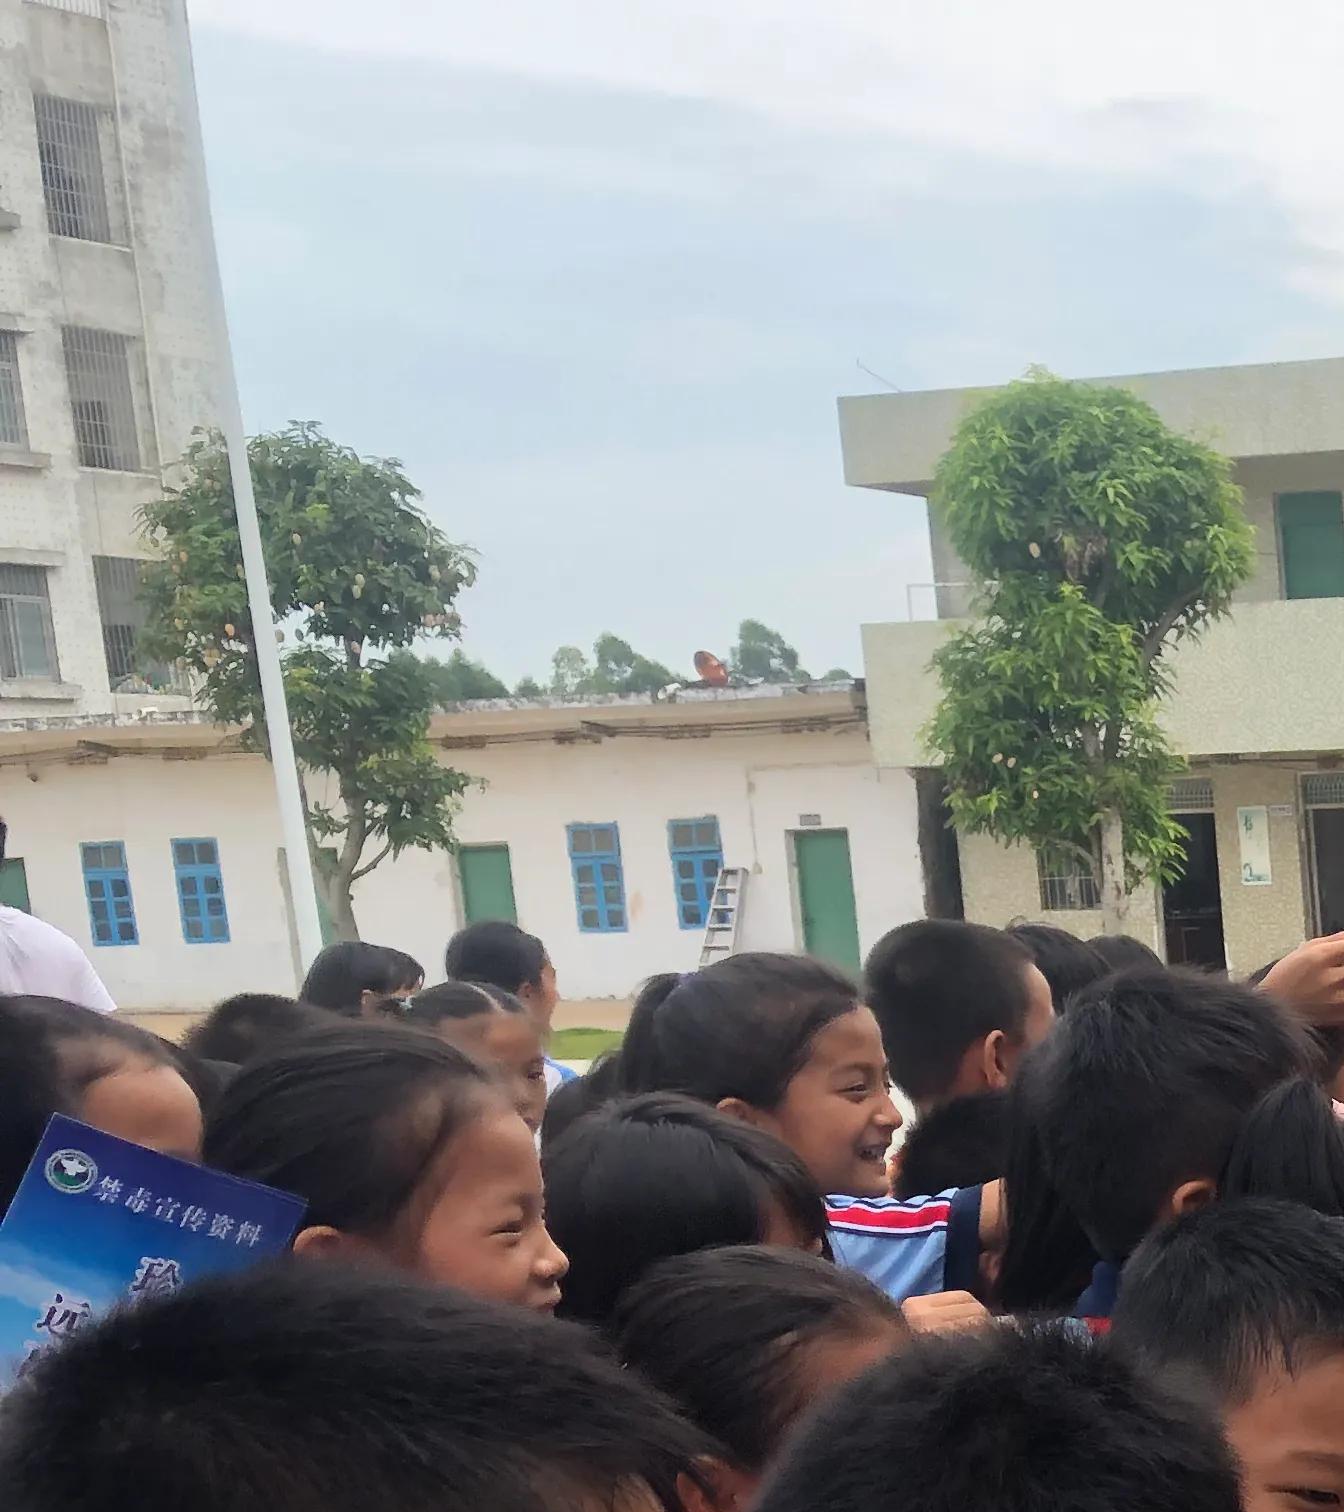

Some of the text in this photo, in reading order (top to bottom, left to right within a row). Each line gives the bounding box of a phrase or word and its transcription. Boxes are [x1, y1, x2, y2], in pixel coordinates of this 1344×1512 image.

[93, 1175, 263, 1248] 禁毒宣传资料
